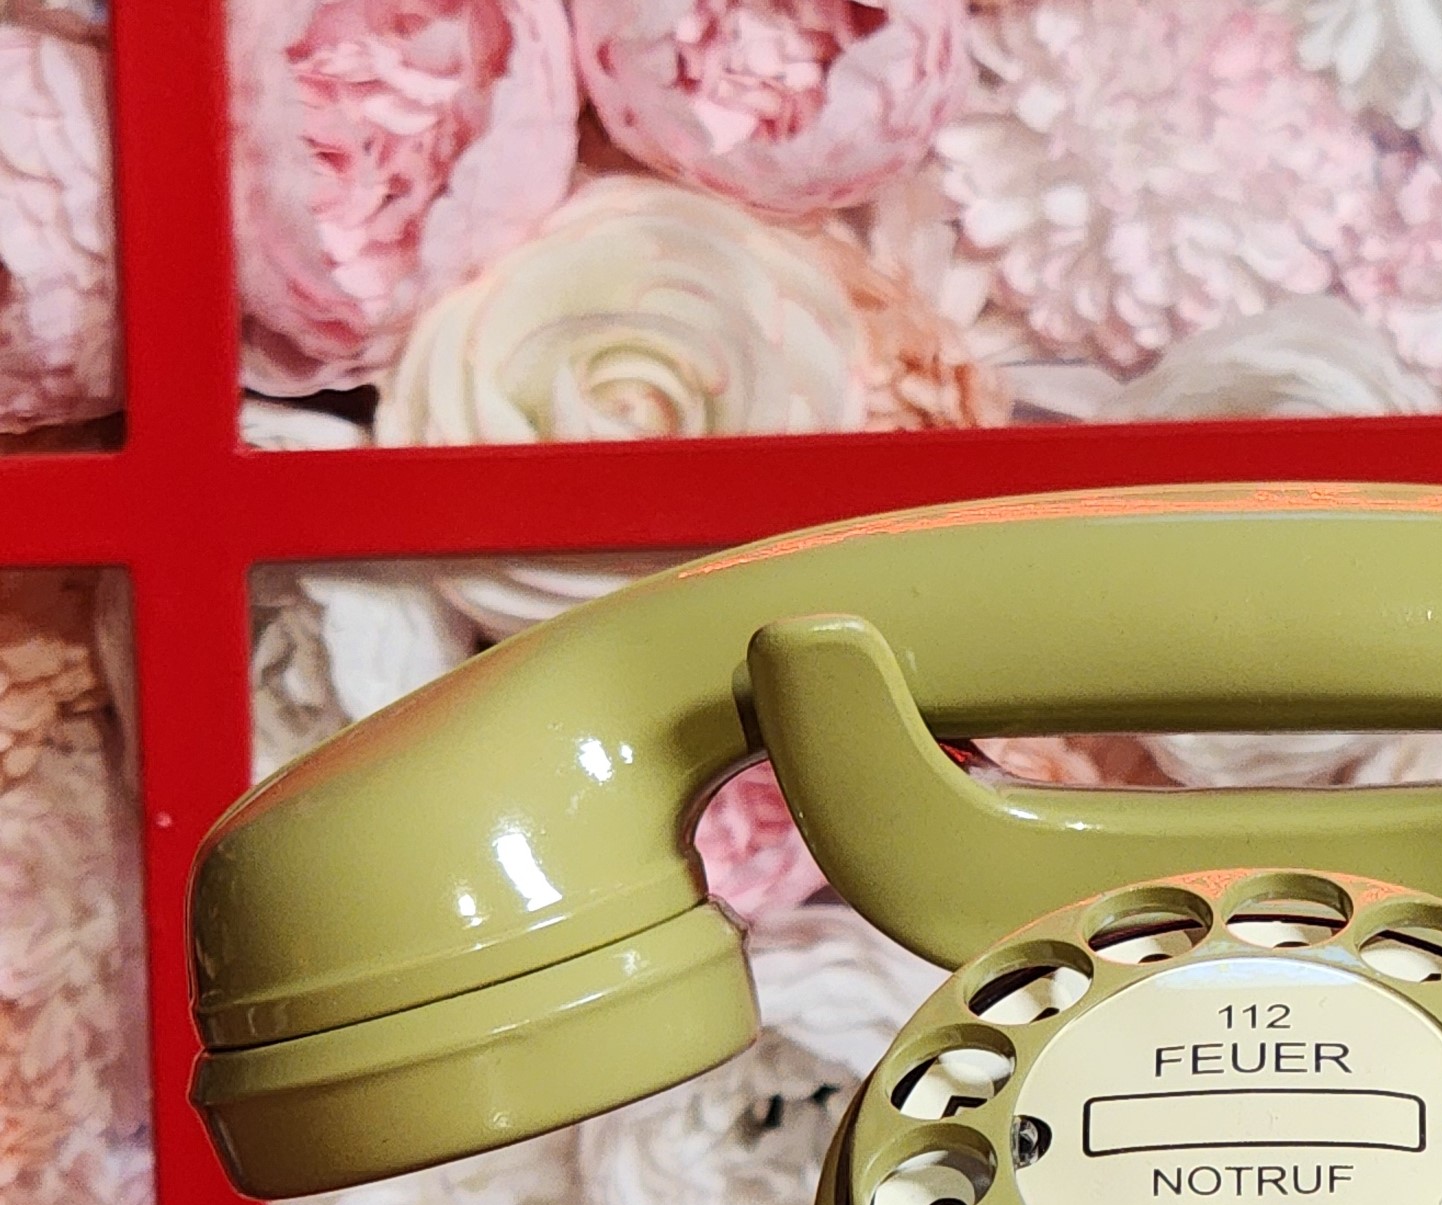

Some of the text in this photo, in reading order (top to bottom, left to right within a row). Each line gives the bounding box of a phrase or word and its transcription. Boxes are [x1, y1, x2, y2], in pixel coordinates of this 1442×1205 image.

[1218, 1003, 1291, 1029] 112
[1155, 1042, 1352, 1078] FEUER
[1153, 1165, 1354, 1197] NOTRUF
